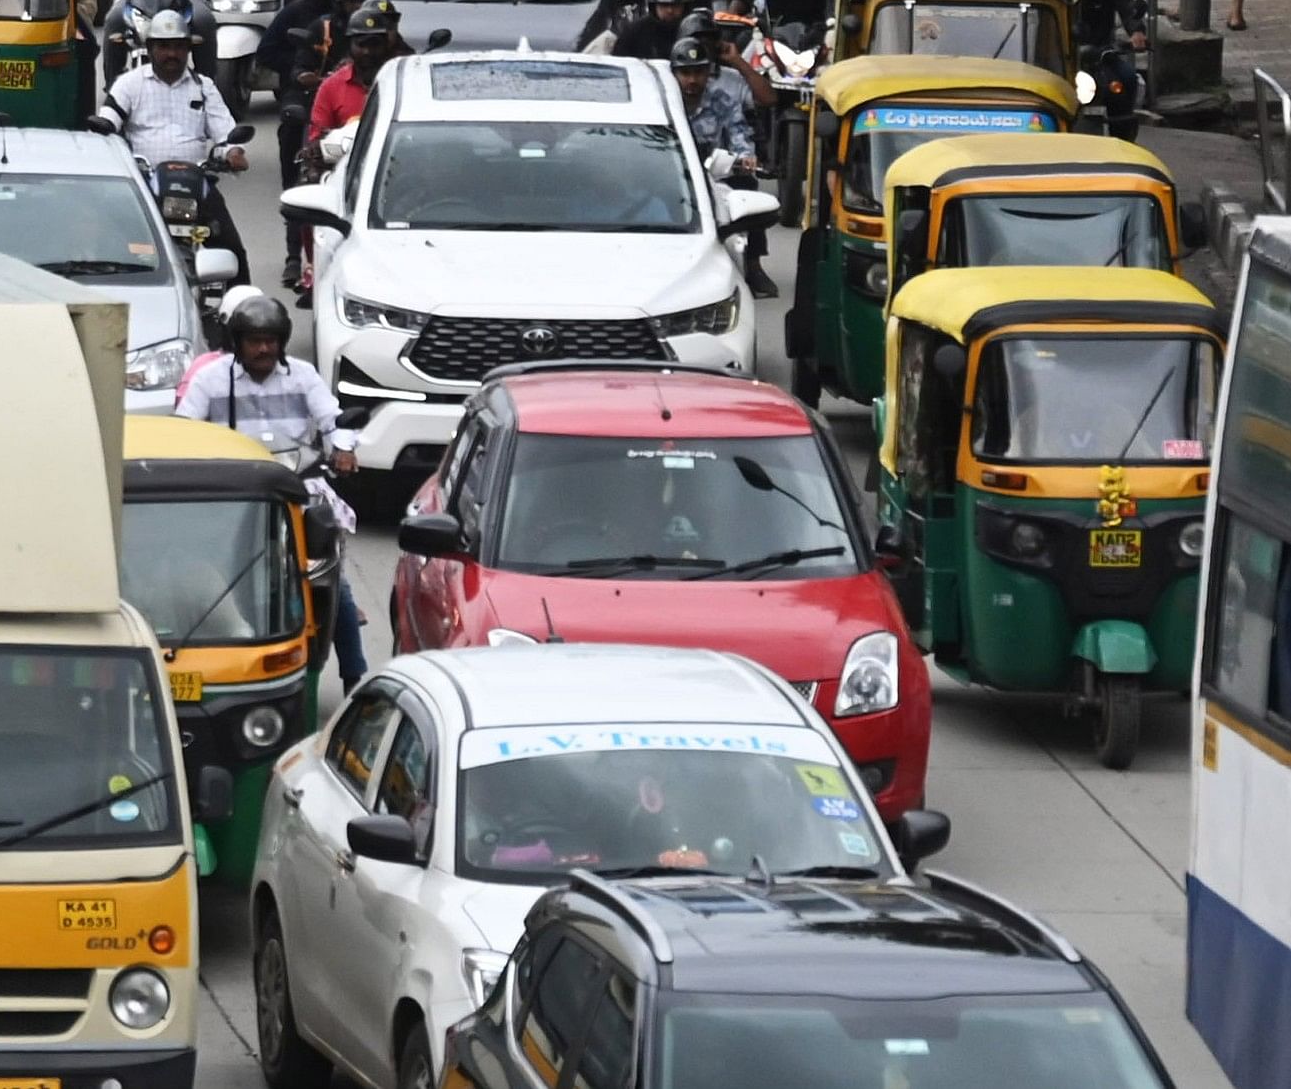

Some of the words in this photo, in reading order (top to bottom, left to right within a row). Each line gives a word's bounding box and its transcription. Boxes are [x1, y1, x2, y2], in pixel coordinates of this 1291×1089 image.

[498, 738, 585, 757] L.V.
[609, 730, 787, 756] Travels
[65, 902, 86, 912] KA
[91, 902, 108, 912] 41
[78, 917, 112, 928] 4535
